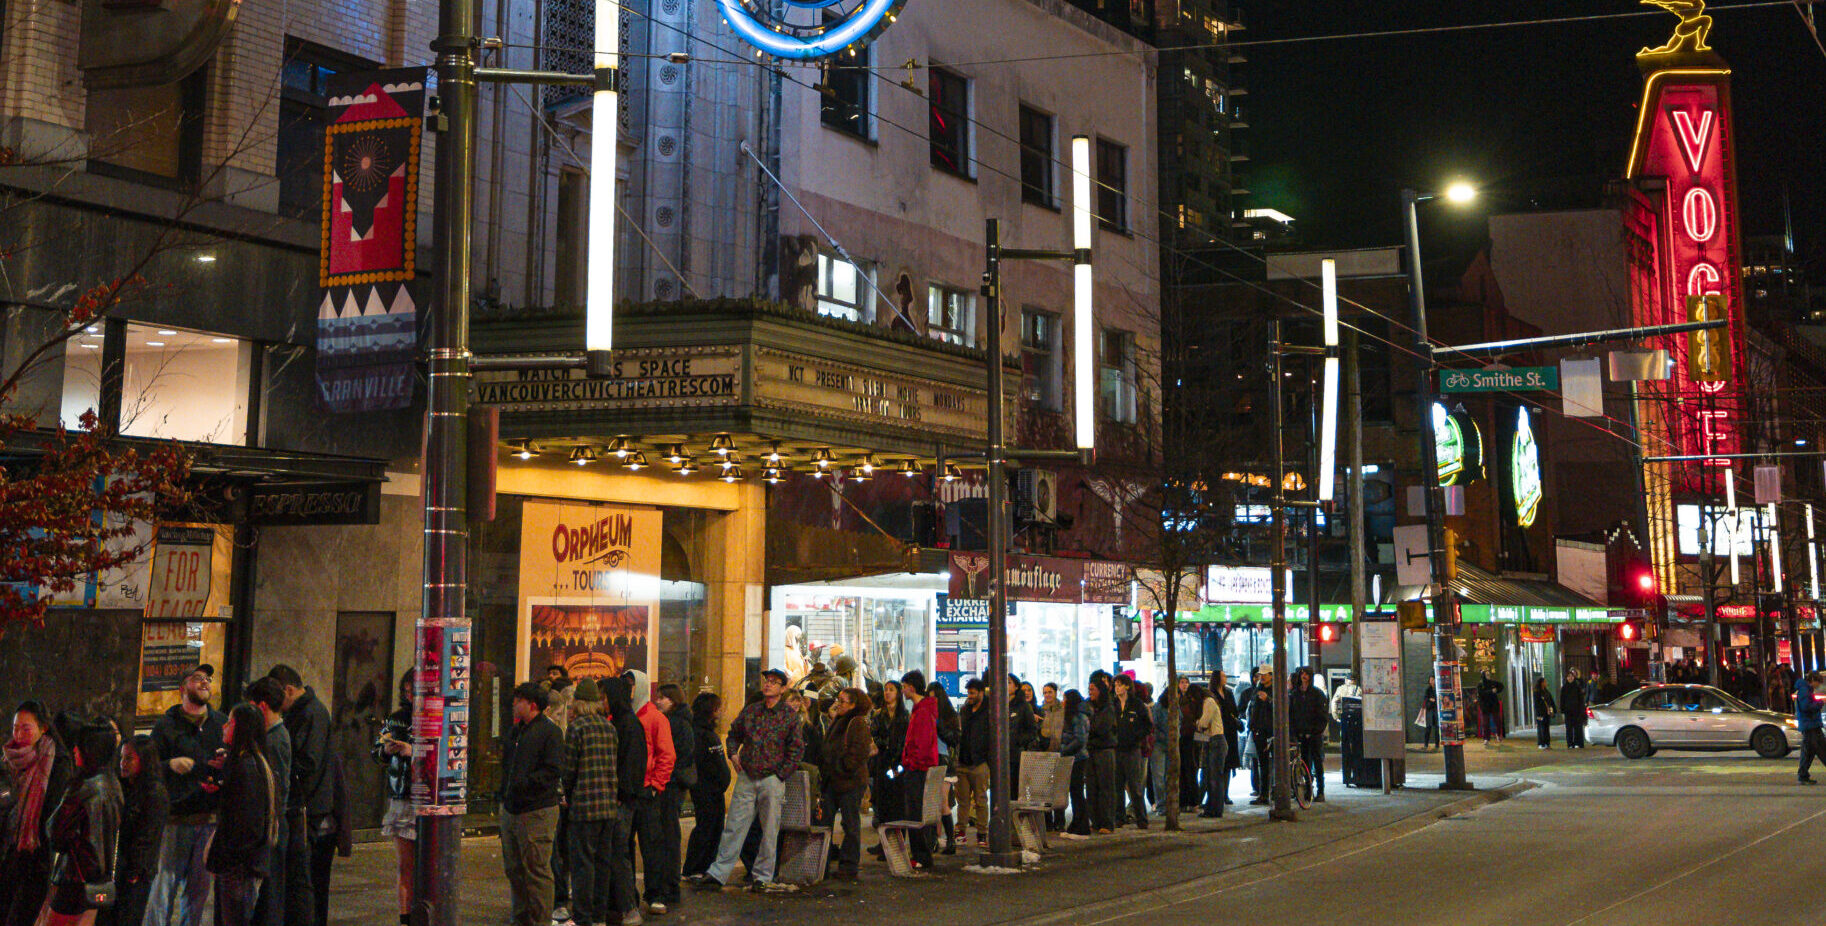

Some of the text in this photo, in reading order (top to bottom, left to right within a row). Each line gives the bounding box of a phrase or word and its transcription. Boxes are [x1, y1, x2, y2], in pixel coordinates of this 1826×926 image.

[1672, 110, 1731, 465] VOGE
[640, 359, 691, 378] SPACE
[788, 364, 805, 384] VCT
[1473, 371, 1547, 388] Smithe St.
[552, 513, 633, 564] ORPHEUM
[164, 550, 200, 593] FOR
[572, 569, 612, 591] TOURS
[1089, 562, 1126, 580] CURRENCY
[946, 598, 989, 607] CURRE
